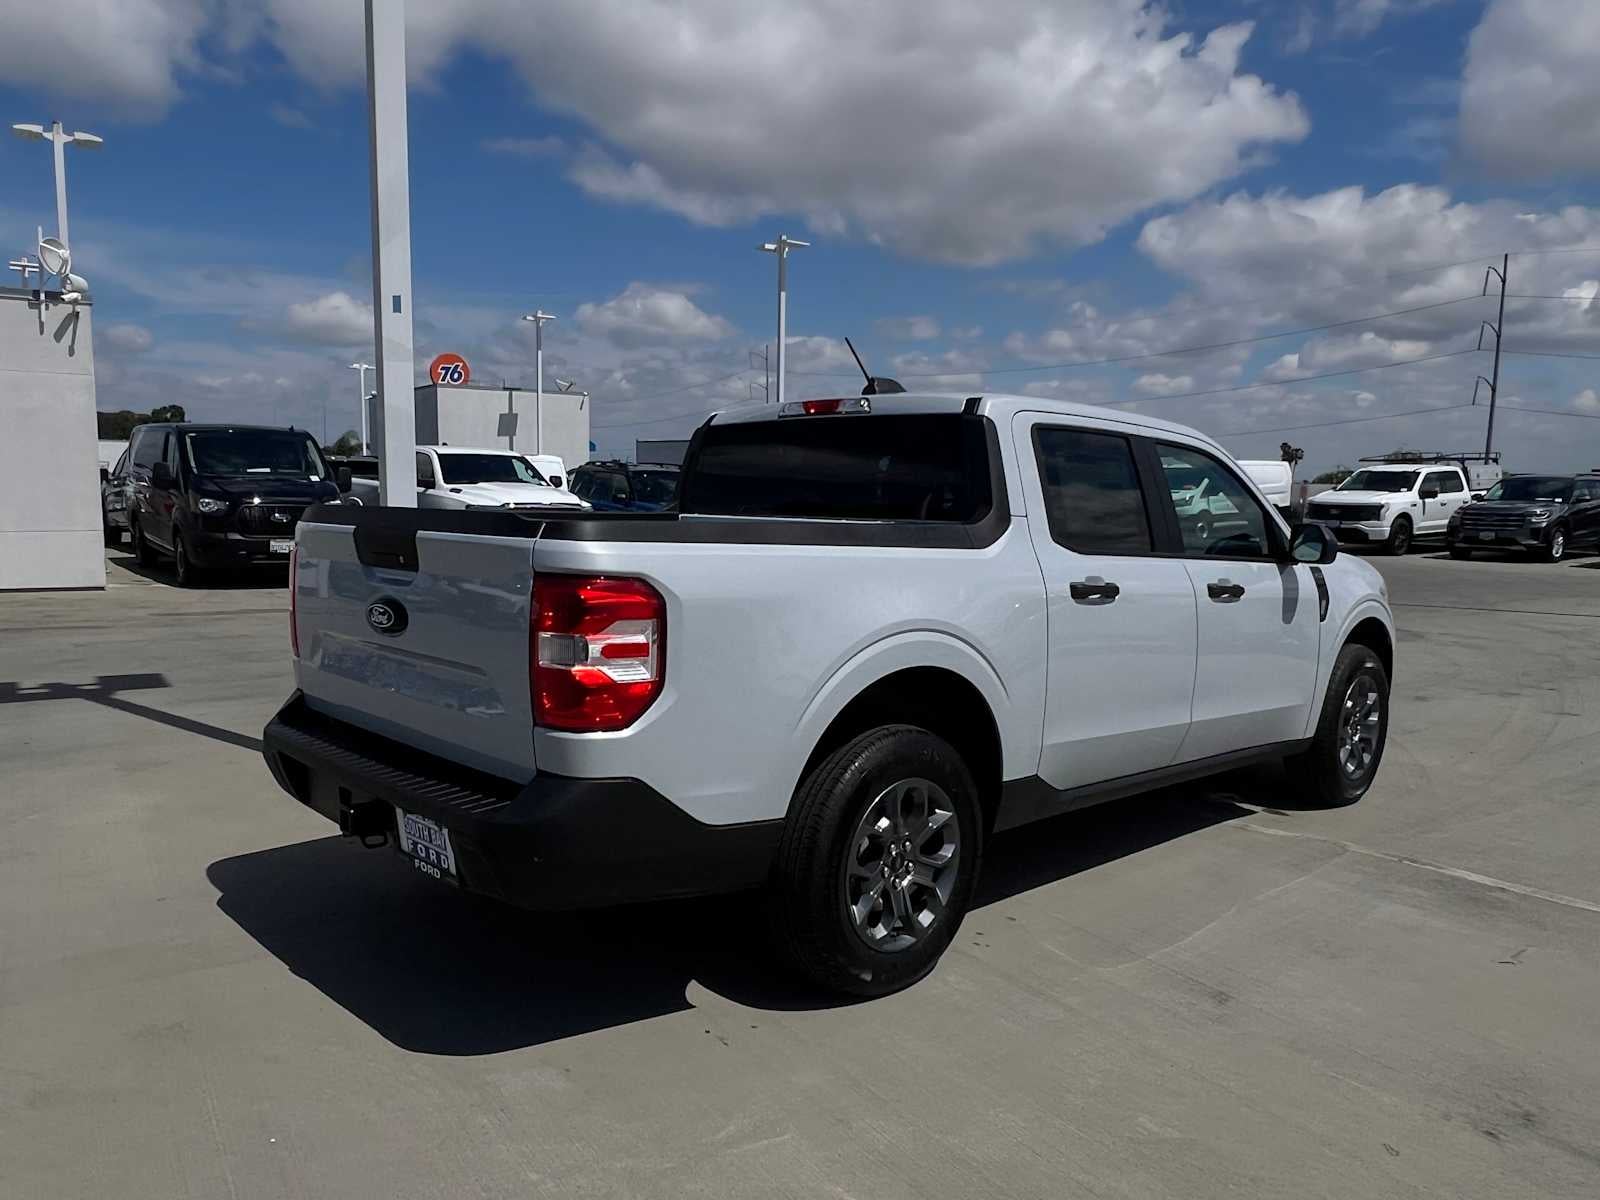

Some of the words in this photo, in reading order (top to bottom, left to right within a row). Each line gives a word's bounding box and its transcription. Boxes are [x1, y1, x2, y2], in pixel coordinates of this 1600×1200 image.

[438, 362, 465, 385] 76
[370, 605, 390, 625] Ford
[407, 838, 449, 869] FORD
[414, 859, 441, 879] FORD
